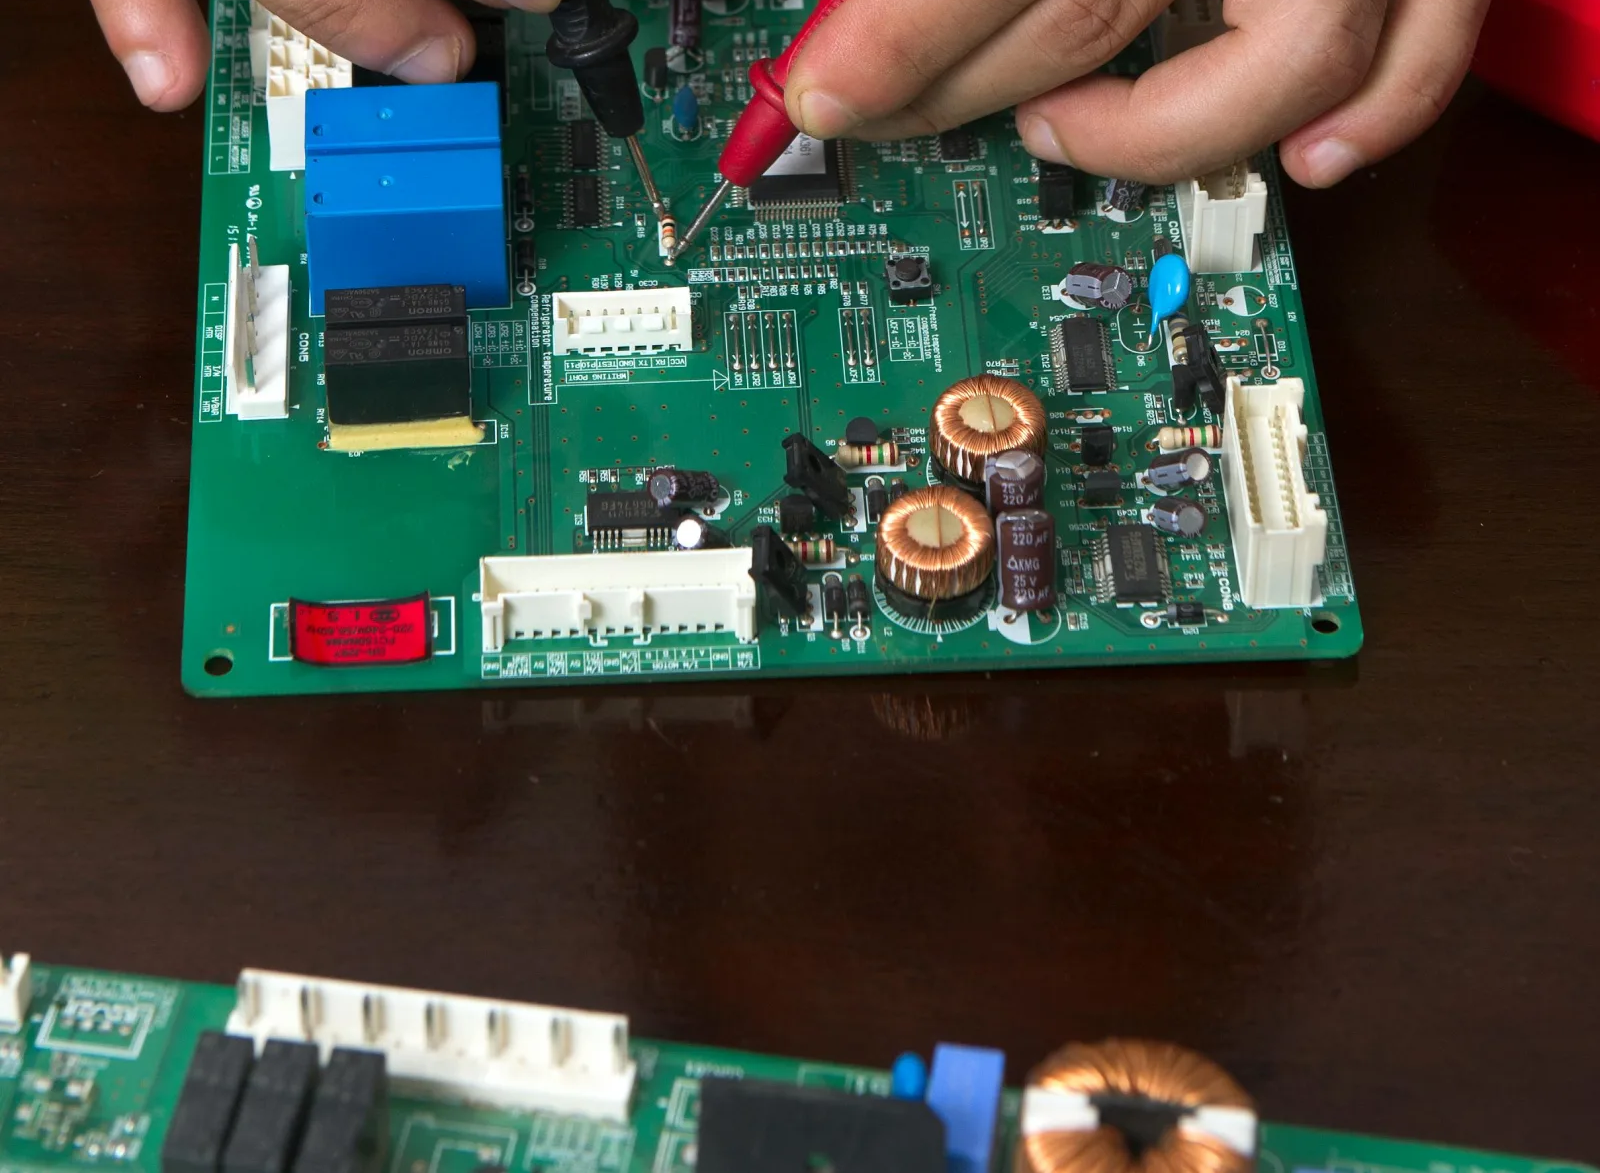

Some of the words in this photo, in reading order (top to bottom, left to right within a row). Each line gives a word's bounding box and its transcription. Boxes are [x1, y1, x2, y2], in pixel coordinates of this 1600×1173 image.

[616, 196, 624, 209] IC11
[747, 228, 755, 239] R22
[785, 224, 794, 238] CC14
[799, 223, 808, 238] CC13
[1168, 220, 1182, 250] CON7
[735, 234, 743, 245] R21
[299, 253, 308, 265] RY4
[614, 273, 623, 288] R129
[630, 270, 638, 278] 5V
[592, 277, 600, 289] R30
[600, 274, 608, 290] R130
[790, 284, 798, 295] R27
[843, 295, 851, 306] R78
[859, 294, 868, 305] R77
[530, 295, 541, 348] compensation
[541, 295, 552, 347] Refrigerator
[928, 306, 938, 332] Freezer
[1288, 311, 1297, 322] 12V
[205, 326, 214, 339] HTR
[474, 323, 483, 338] JCR4
[487, 323, 496, 338] JCR3
[500, 322, 509, 337] JCR2
[514, 322, 524, 337] JCR1
[889, 319, 898, 334] JCF4
[905, 319, 914, 334] JCF3
[920, 316, 933, 359] compensation
[298, 332, 310, 363] CON5
[930, 333, 943, 373] temperature
[566, 361, 580, 369] P11
[597, 360, 617, 368] TEST
[618, 359, 634, 367] GND
[637, 358, 648, 366] TX
[655, 358, 665, 366] RX
[670, 358, 685, 366] VCC
[1041, 353, 1049, 368] IC12
[203, 365, 213, 378] HTR
[542, 350, 553, 401] temperature
[568, 373, 588, 382] PORT
[733, 371, 744, 386] JCR1
[752, 371, 761, 386] JCR2
[771, 370, 780, 386] JCR3
[787, 369, 797, 384] JCR4
[848, 366, 858, 382] JCF4
[866, 366, 876, 382] JCF3
[316, 373, 326, 386] RY9
[1041, 377, 1049, 387] 12V
[202, 400, 211, 413] HTR
[1144, 393, 1153, 409] R276
[316, 407, 325, 423] RY14
[1146, 410, 1156, 426] R275
[1203, 408, 1213, 424] R273
[500, 423, 509, 439] IC15
[1018, 483, 1026, 494] V
[734, 489, 743, 505] CE15
[1003, 494, 1023, 505] 220
[1012, 533, 1033, 545] 220
[1017, 559, 1040, 571] KMG
[1014, 575, 1026, 587] 25
[1029, 575, 1036, 586] V
[1014, 588, 1035, 601] 220
[652, 662, 678, 670] MOTOR
